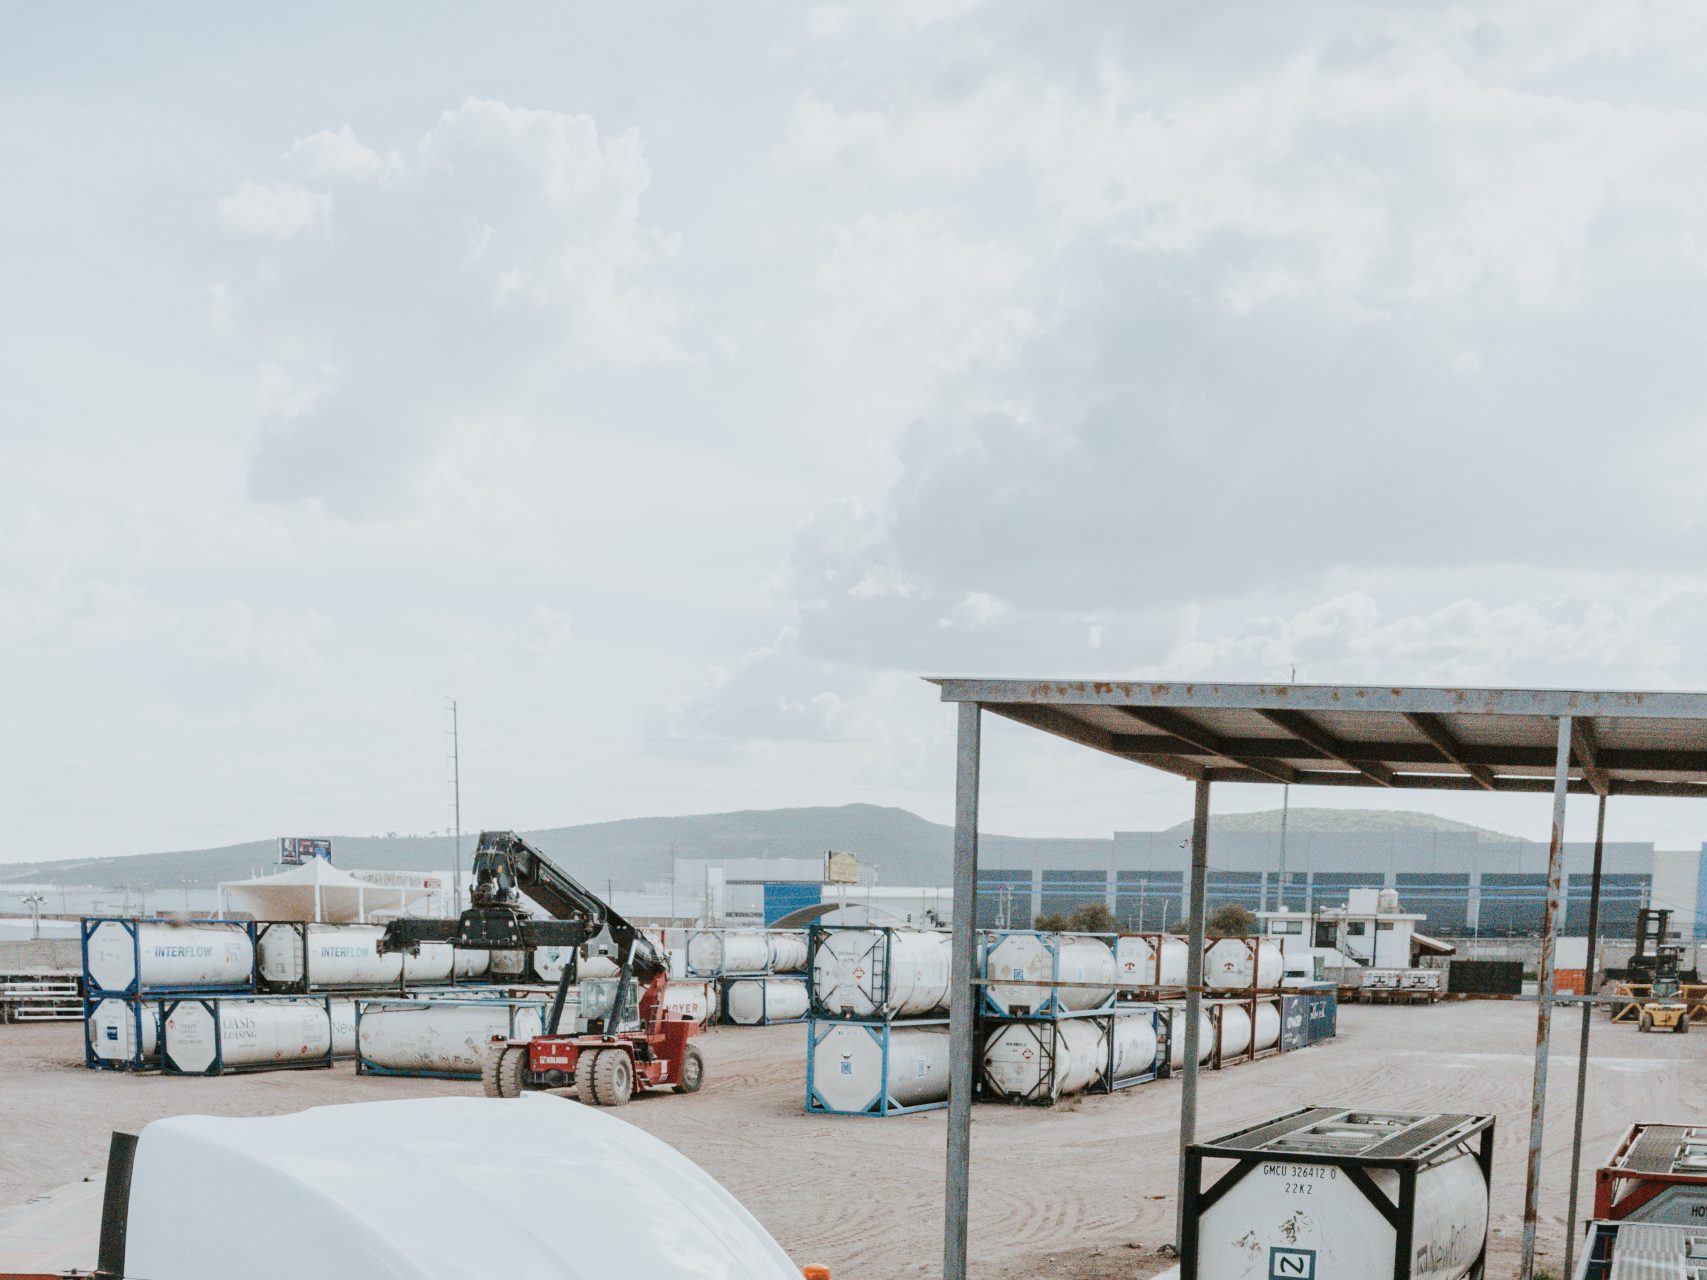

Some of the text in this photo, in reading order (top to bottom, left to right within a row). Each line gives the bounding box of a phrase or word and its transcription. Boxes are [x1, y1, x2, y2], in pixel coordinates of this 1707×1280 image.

[155, 946, 213, 958] INTERFLOW
[321, 946, 370, 958] INTERFLOW
[223, 1017, 256, 1030] OASIS
[223, 1030, 257, 1040] LEASING
[1263, 1165, 1336, 1179] GMCU 326412 0
[1285, 1183, 1313, 1195] 22K2
[1691, 1205, 1707, 1217] HO
